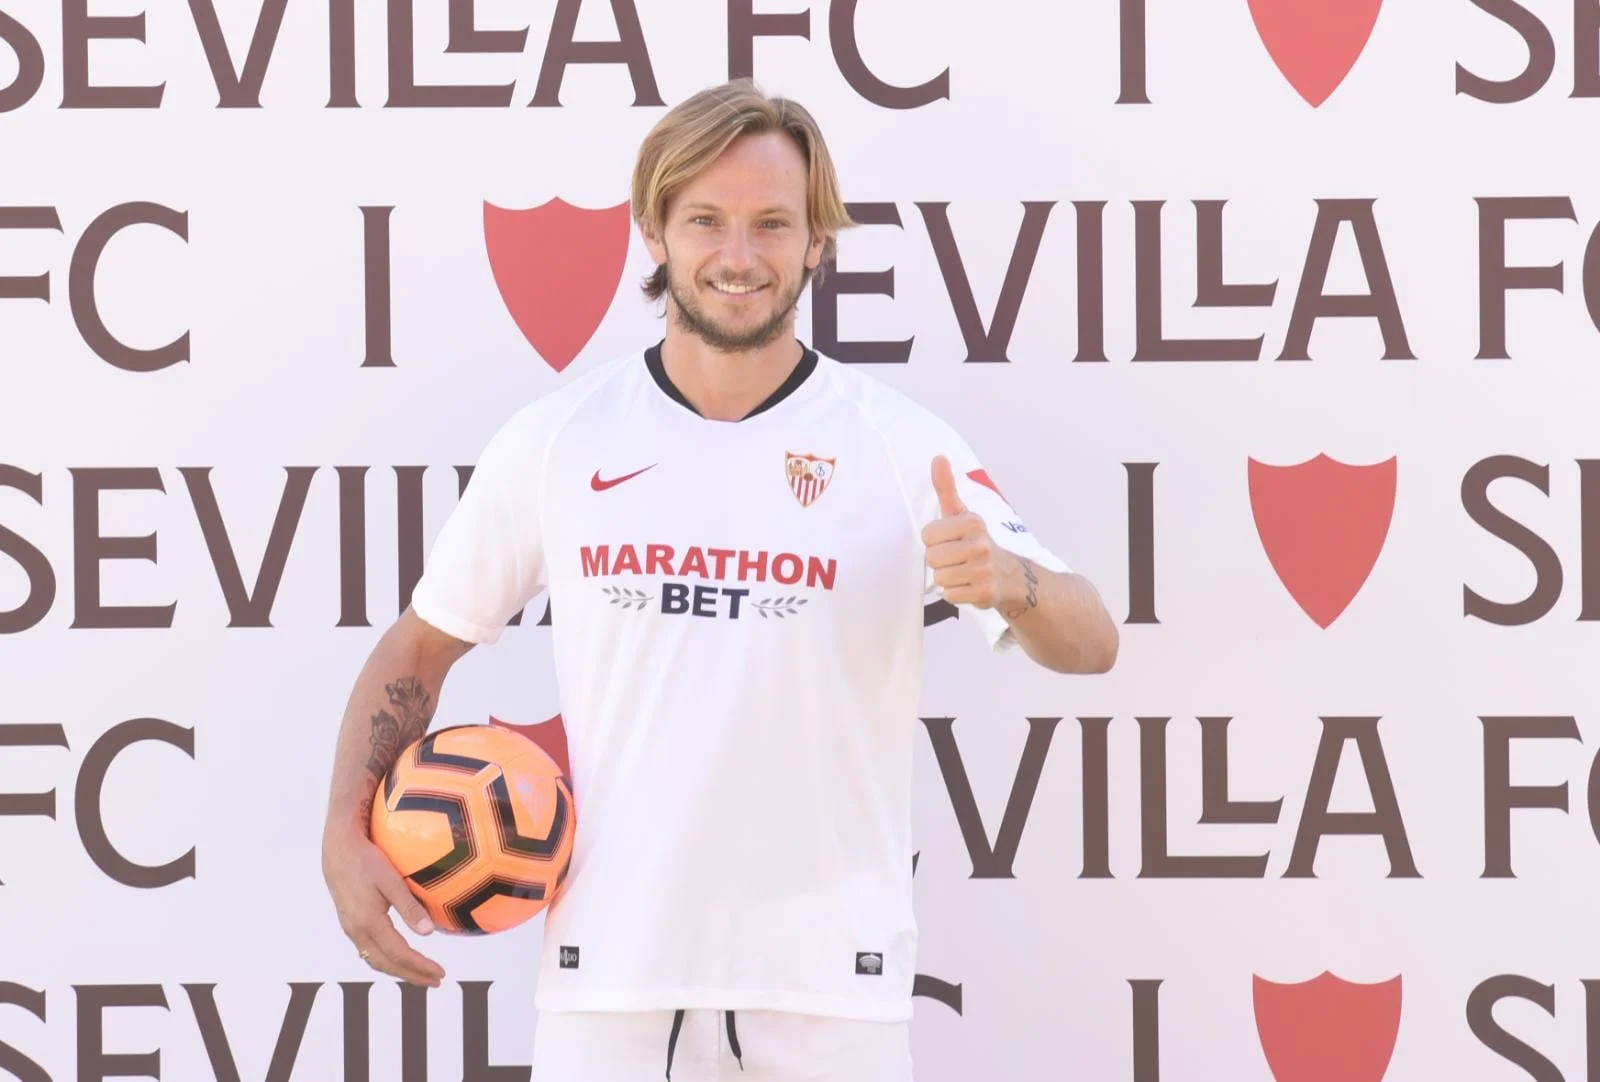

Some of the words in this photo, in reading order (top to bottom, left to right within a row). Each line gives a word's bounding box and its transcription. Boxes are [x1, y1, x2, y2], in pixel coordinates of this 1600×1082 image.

[1115, 0, 1152, 104] I
[359, 206, 397, 367] I
[812, 198, 1417, 364] EVILLA
[1473, 196, 1600, 360] F
[580, 544, 837, 591] MARATHON
[1121, 462, 1161, 625] I
[661, 582, 750, 619] BET
[912, 716, 1424, 880] VILLA
[1477, 715, 1600, 879] F
[1126, 978, 1164, 1082] I
[1466, 973, 1600, 1082] S
